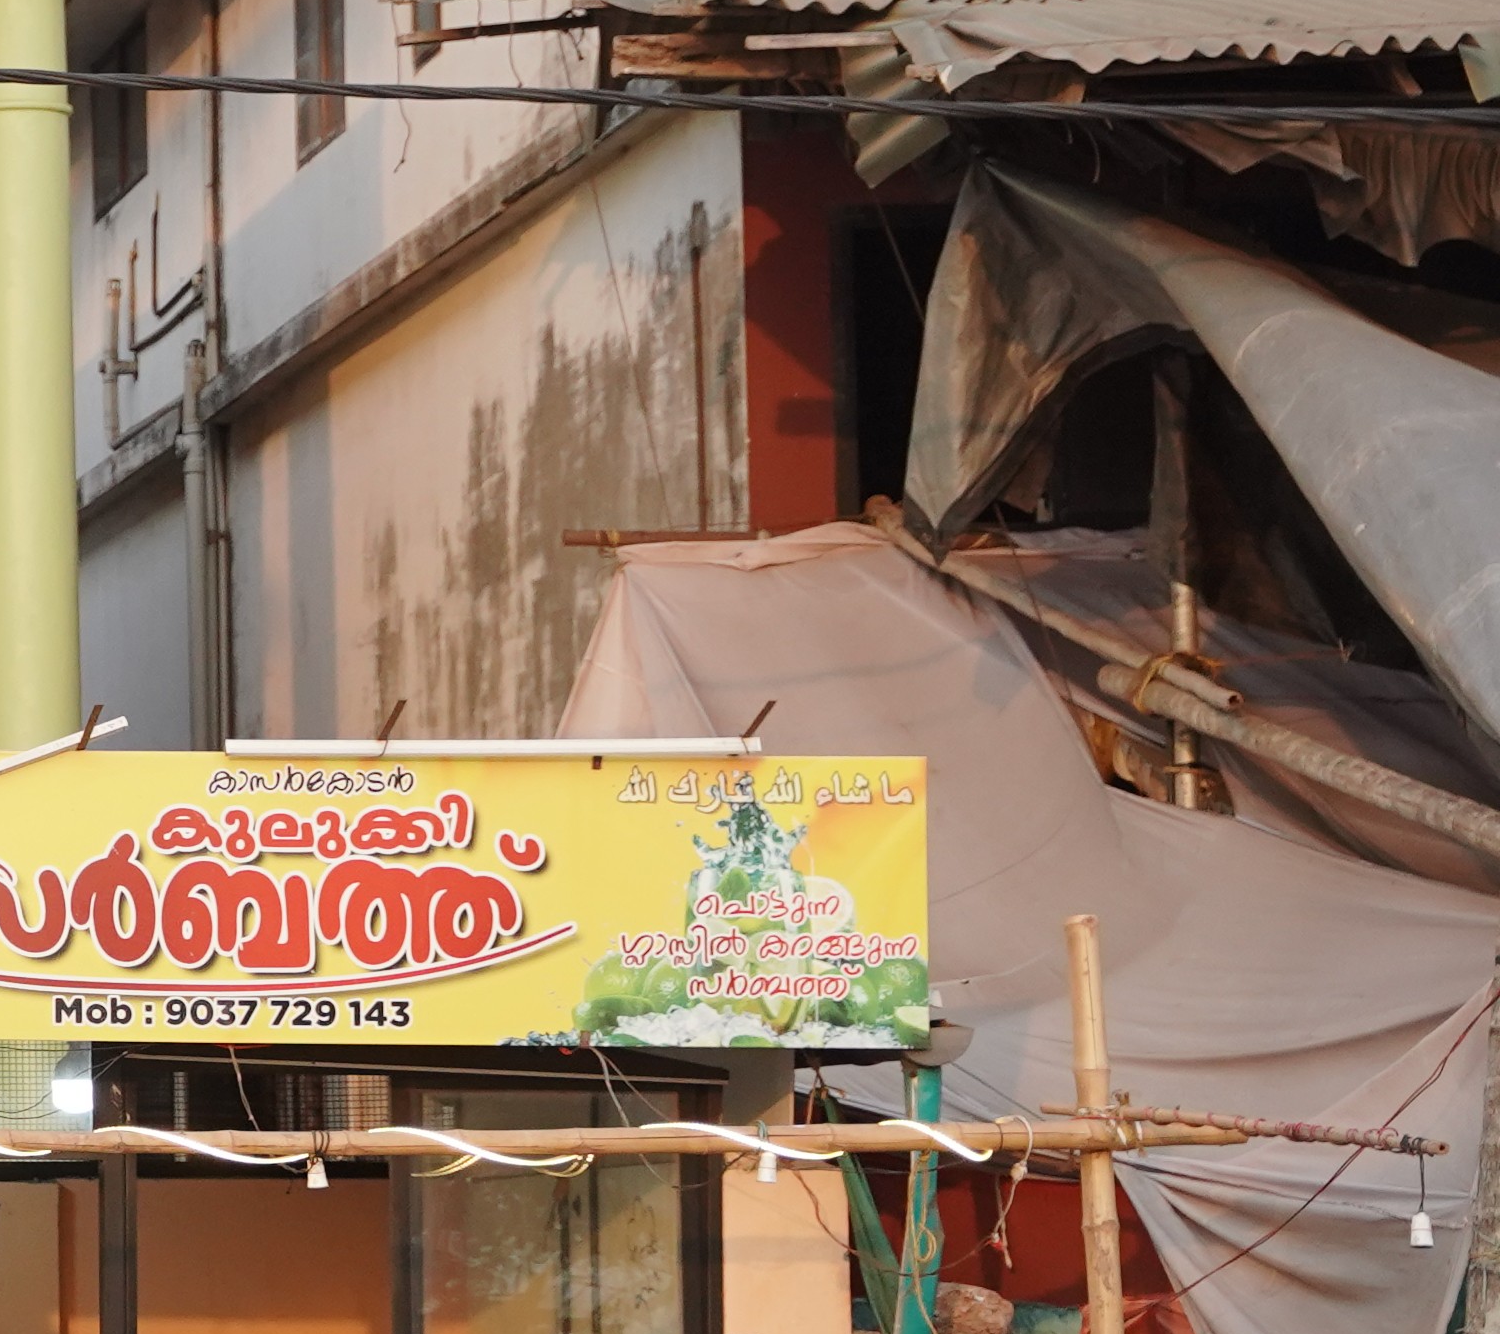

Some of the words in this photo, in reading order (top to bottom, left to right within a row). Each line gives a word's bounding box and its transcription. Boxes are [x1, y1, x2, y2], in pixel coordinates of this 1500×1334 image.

[156, 794, 471, 859] കുലുക്കി
[55, 998, 133, 1026] Mob
[166, 999, 258, 1027] 9037
[271, 1000, 336, 1027] 729
[349, 1000, 411, 1027] 143
